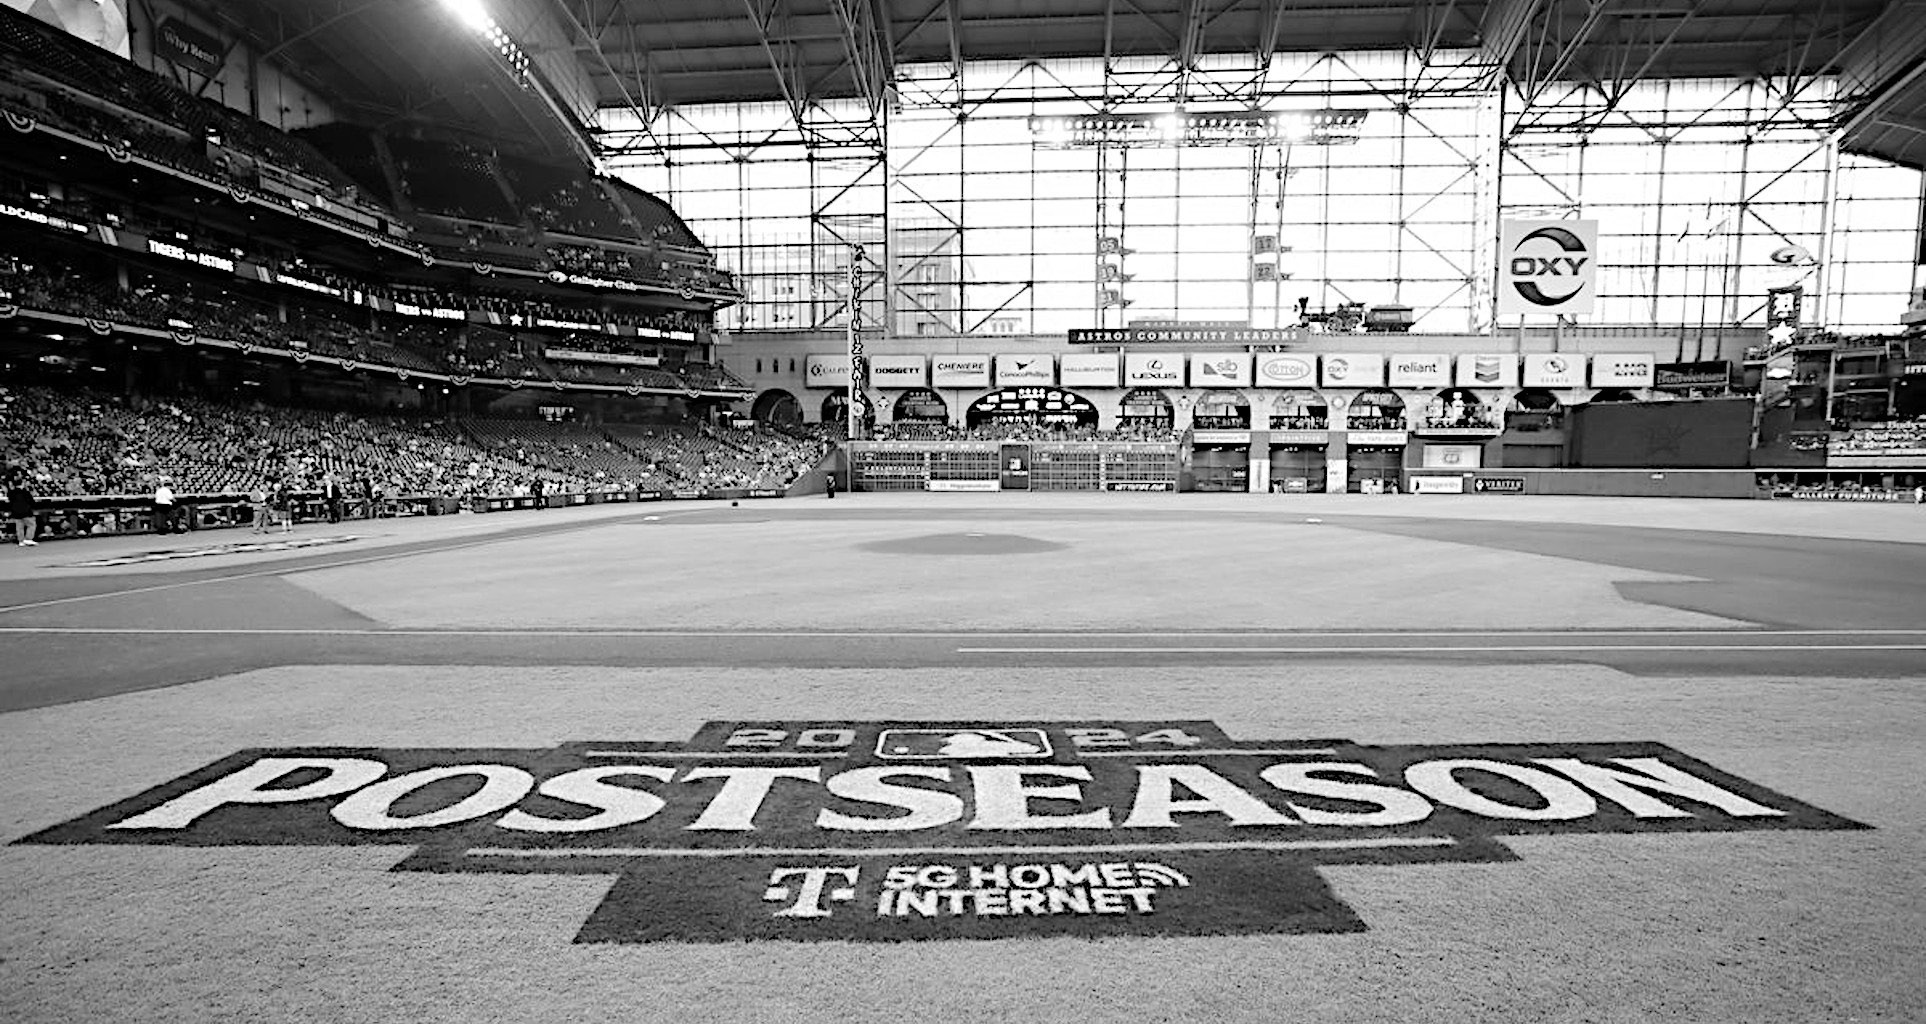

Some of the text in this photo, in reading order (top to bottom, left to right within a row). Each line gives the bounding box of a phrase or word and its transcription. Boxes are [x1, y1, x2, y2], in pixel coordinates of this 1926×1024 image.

[1511, 257, 1589, 276] OXY
[1077, 331, 1298, 342] ASTROS COMMUNITY LEADERS
[875, 367, 920, 375] DOGGETT
[1398, 361, 1438, 373] reliant
[1792, 491, 1899, 500] GALLERY FURNITURE
[726, 729, 857, 748] 20
[1064, 728, 1201, 747] 24
[105, 755, 1791, 834] POSTSEASON
[882, 863, 1138, 889] 5G HOME
[876, 887, 1157, 917] INTERNET
